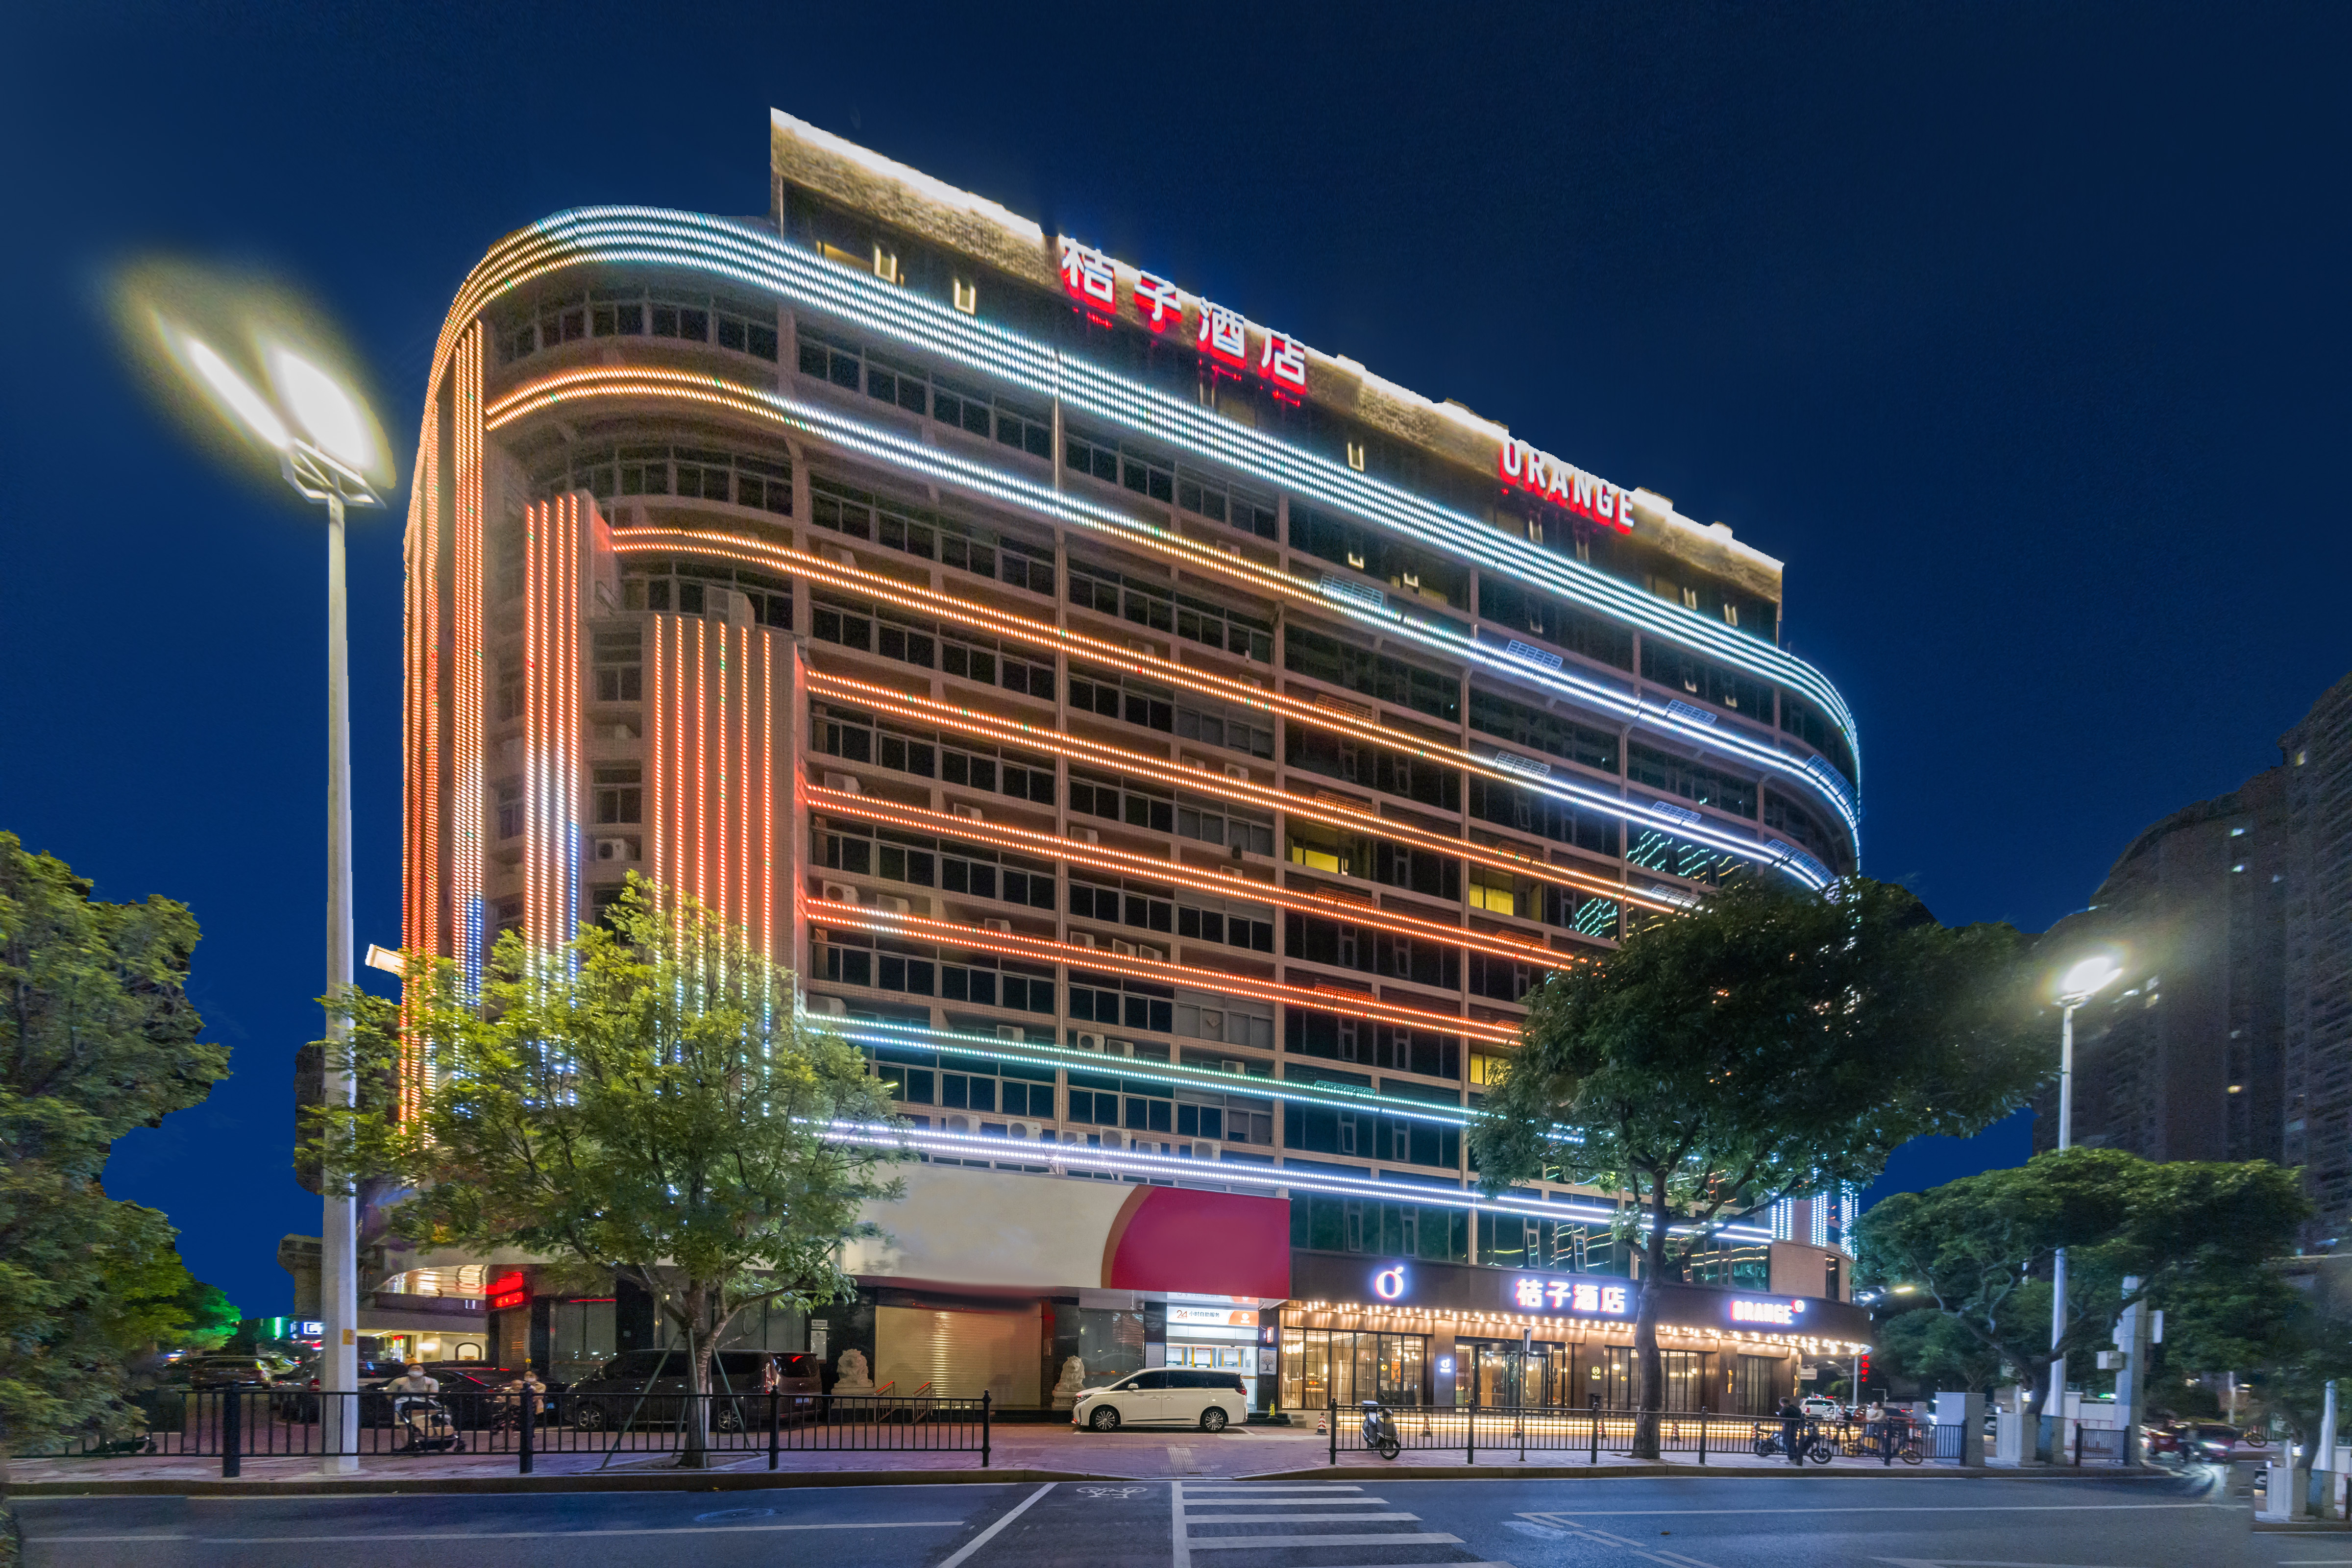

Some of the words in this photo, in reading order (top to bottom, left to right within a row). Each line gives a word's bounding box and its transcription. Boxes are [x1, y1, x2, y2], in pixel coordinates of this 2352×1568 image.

[1061, 243, 1305, 393] 桔子酒店
[1500, 439, 1634, 533] ORANGE
[1515, 1279, 1625, 1313] 桔子酒店
[1731, 1301, 1792, 1324] ORANGE
[1176, 1310, 1188, 1319] 24
